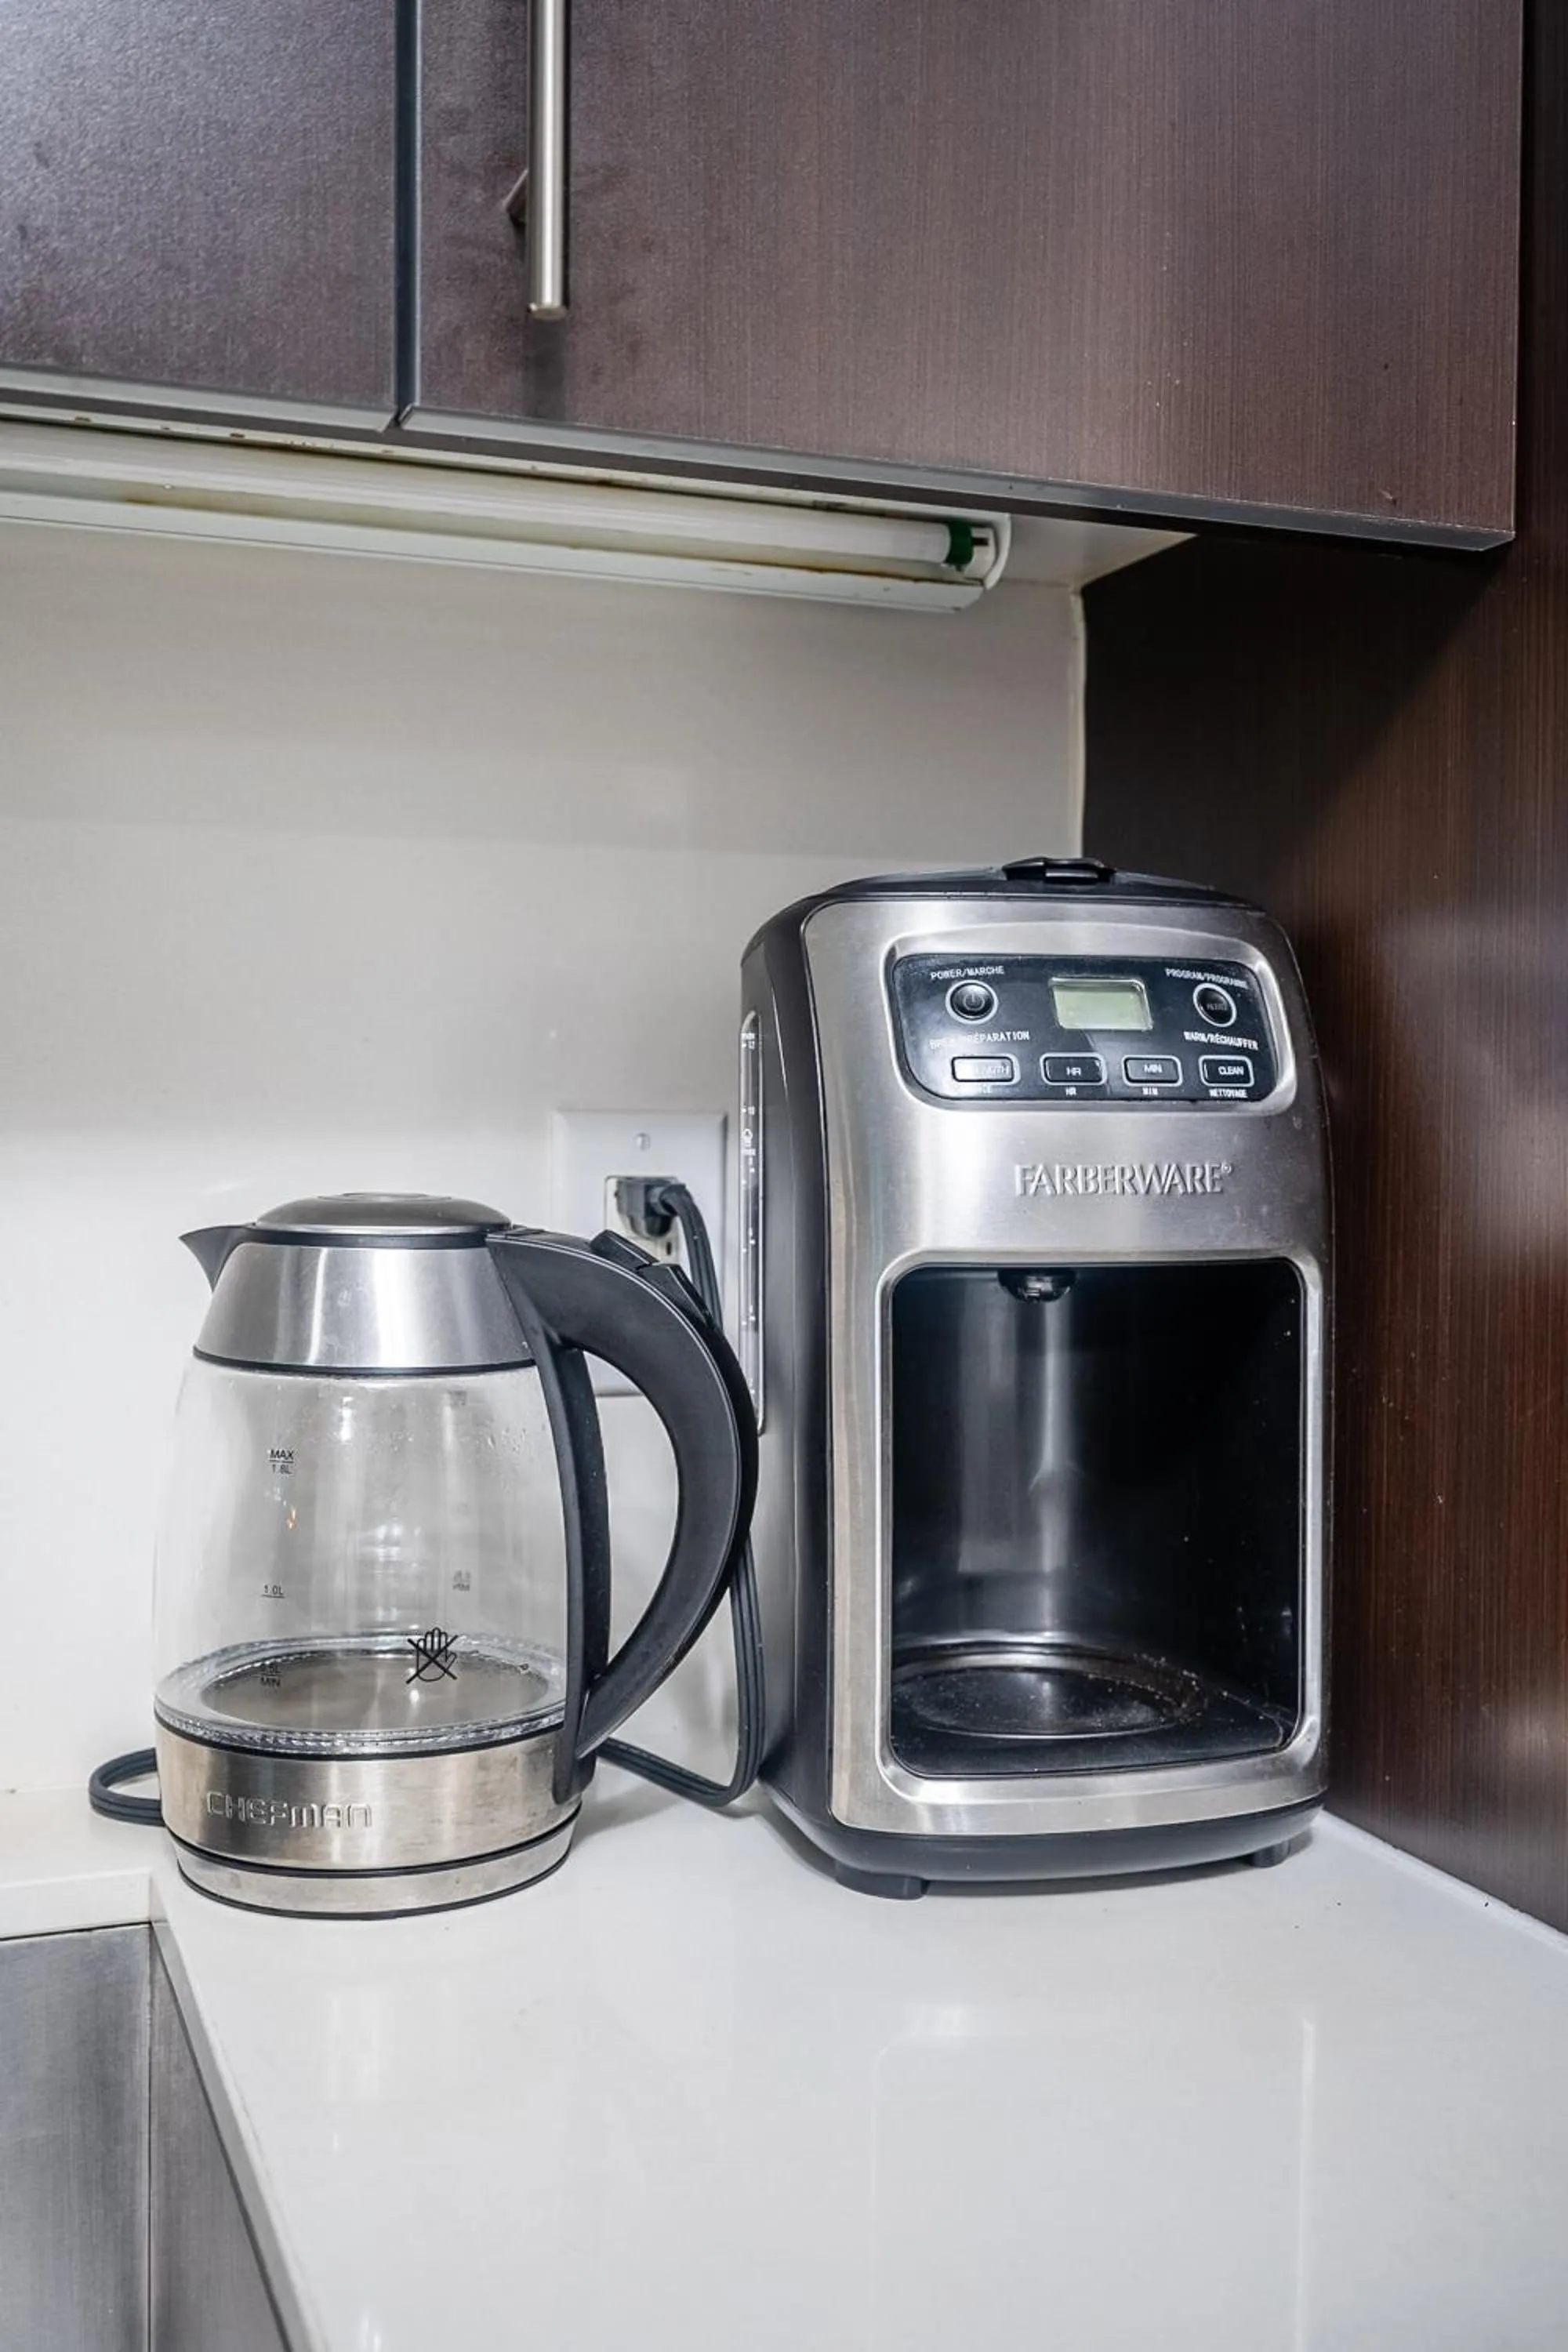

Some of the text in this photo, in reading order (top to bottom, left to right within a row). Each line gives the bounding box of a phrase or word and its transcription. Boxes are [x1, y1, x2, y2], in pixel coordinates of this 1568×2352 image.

[1065, 1066, 1081, 1076] HR
[1143, 1063, 1163, 1074] MIN
[1218, 1065, 1244, 1076] CLEAN
[1065, 1087, 1077, 1096] HR
[270, 1449, 294, 1460] MAX
[264, 1584, 284, 1595] 1.0L
[206, 1791, 372, 1828] CHEFMAN
